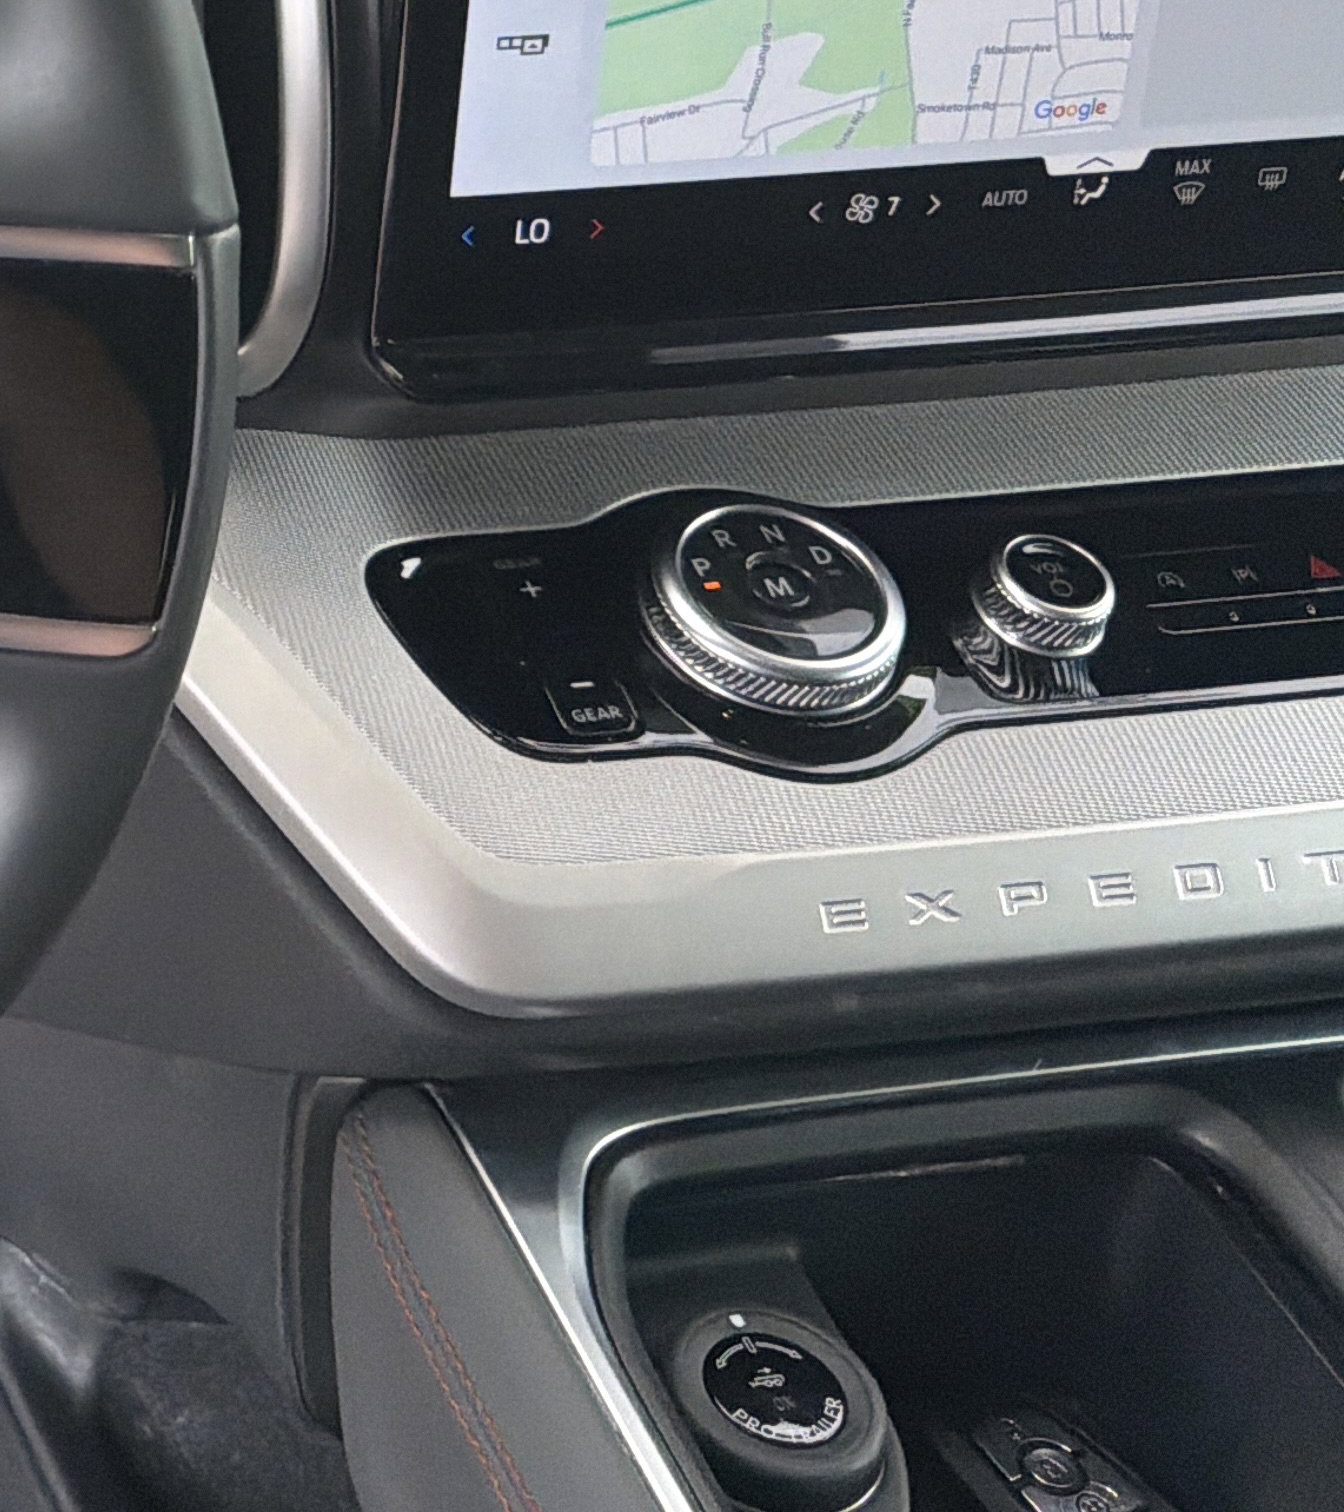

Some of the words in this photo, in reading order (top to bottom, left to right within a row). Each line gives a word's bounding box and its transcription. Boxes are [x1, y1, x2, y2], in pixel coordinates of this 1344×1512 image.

[984, 44, 1030, 56] Madison
[1031, 43, 1053, 54] Ave
[640, 108, 685, 127] Fairview
[687, 104, 701, 116] Dr
[1034, 97, 1108, 121] Google
[1175, 159, 1211, 176] MAX
[887, 195, 901, 217] 7
[982, 190, 1028, 207] AUTO
[515, 217, 551, 245] LO
[712, 530, 736, 549] R
[759, 525, 785, 544] N
[809, 546, 833, 565] D
[691, 557, 712, 577] P
[763, 576, 795, 599] M
[571, 705, 624, 724] GEAR
[731, 1407, 774, 1438] PRO
